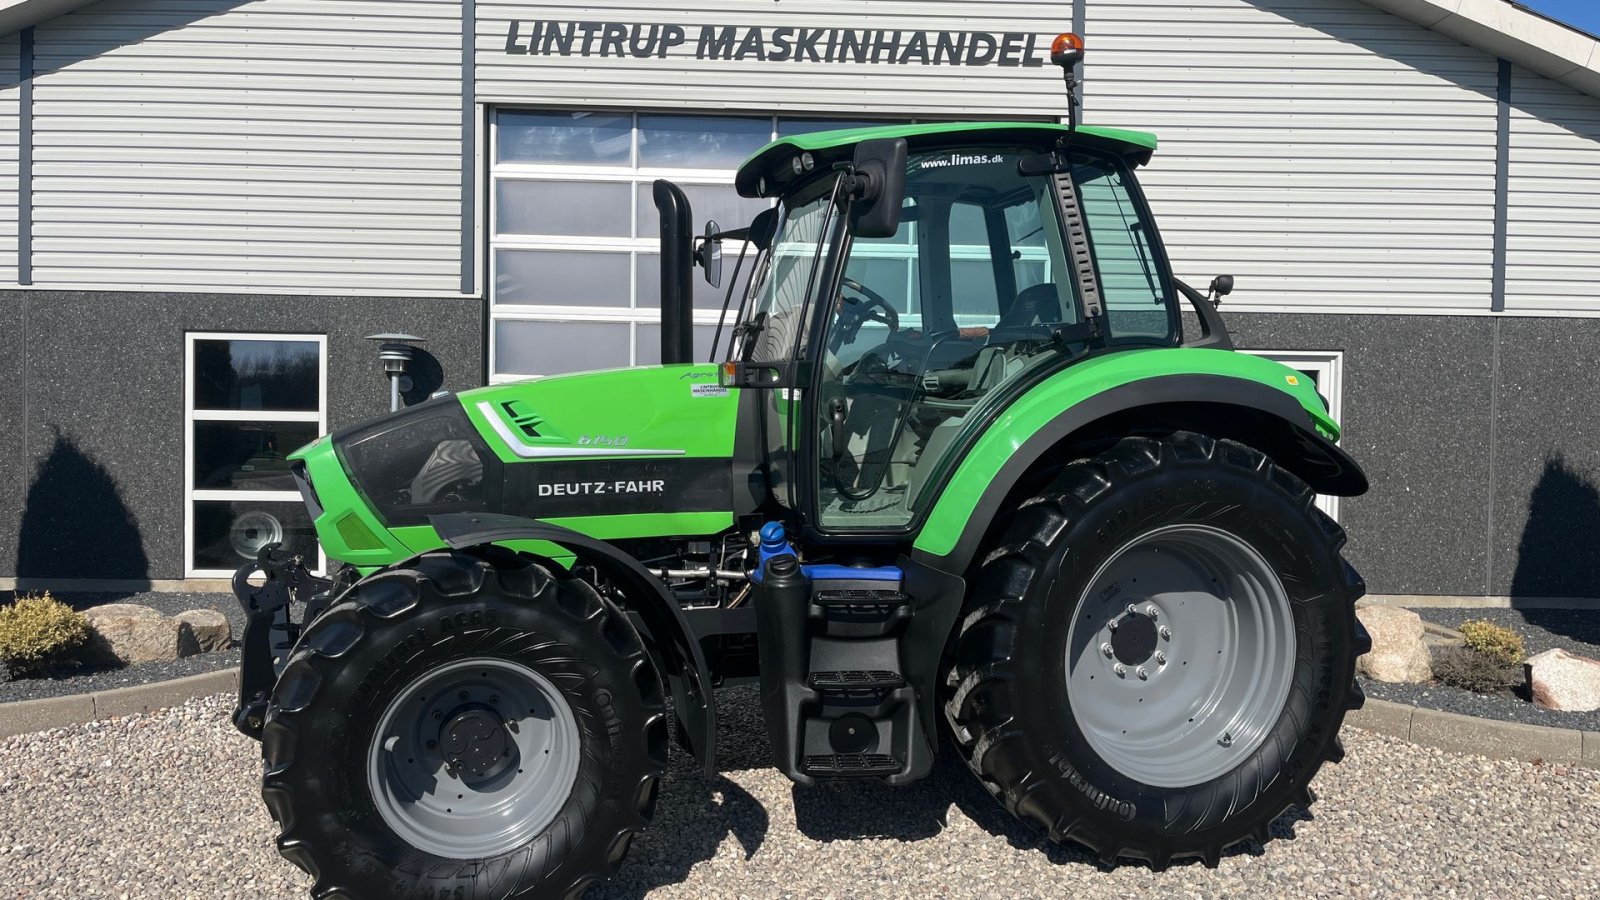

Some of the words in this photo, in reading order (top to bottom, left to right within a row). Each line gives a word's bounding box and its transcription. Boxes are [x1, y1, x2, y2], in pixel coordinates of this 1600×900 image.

[505, 20, 685, 59] LINTRUP
[696, 26, 1044, 67] MASKINHANDEL
[921, 154, 1004, 168] www.limas.dk
[538, 479, 665, 497] DEUTZ-FAHR
